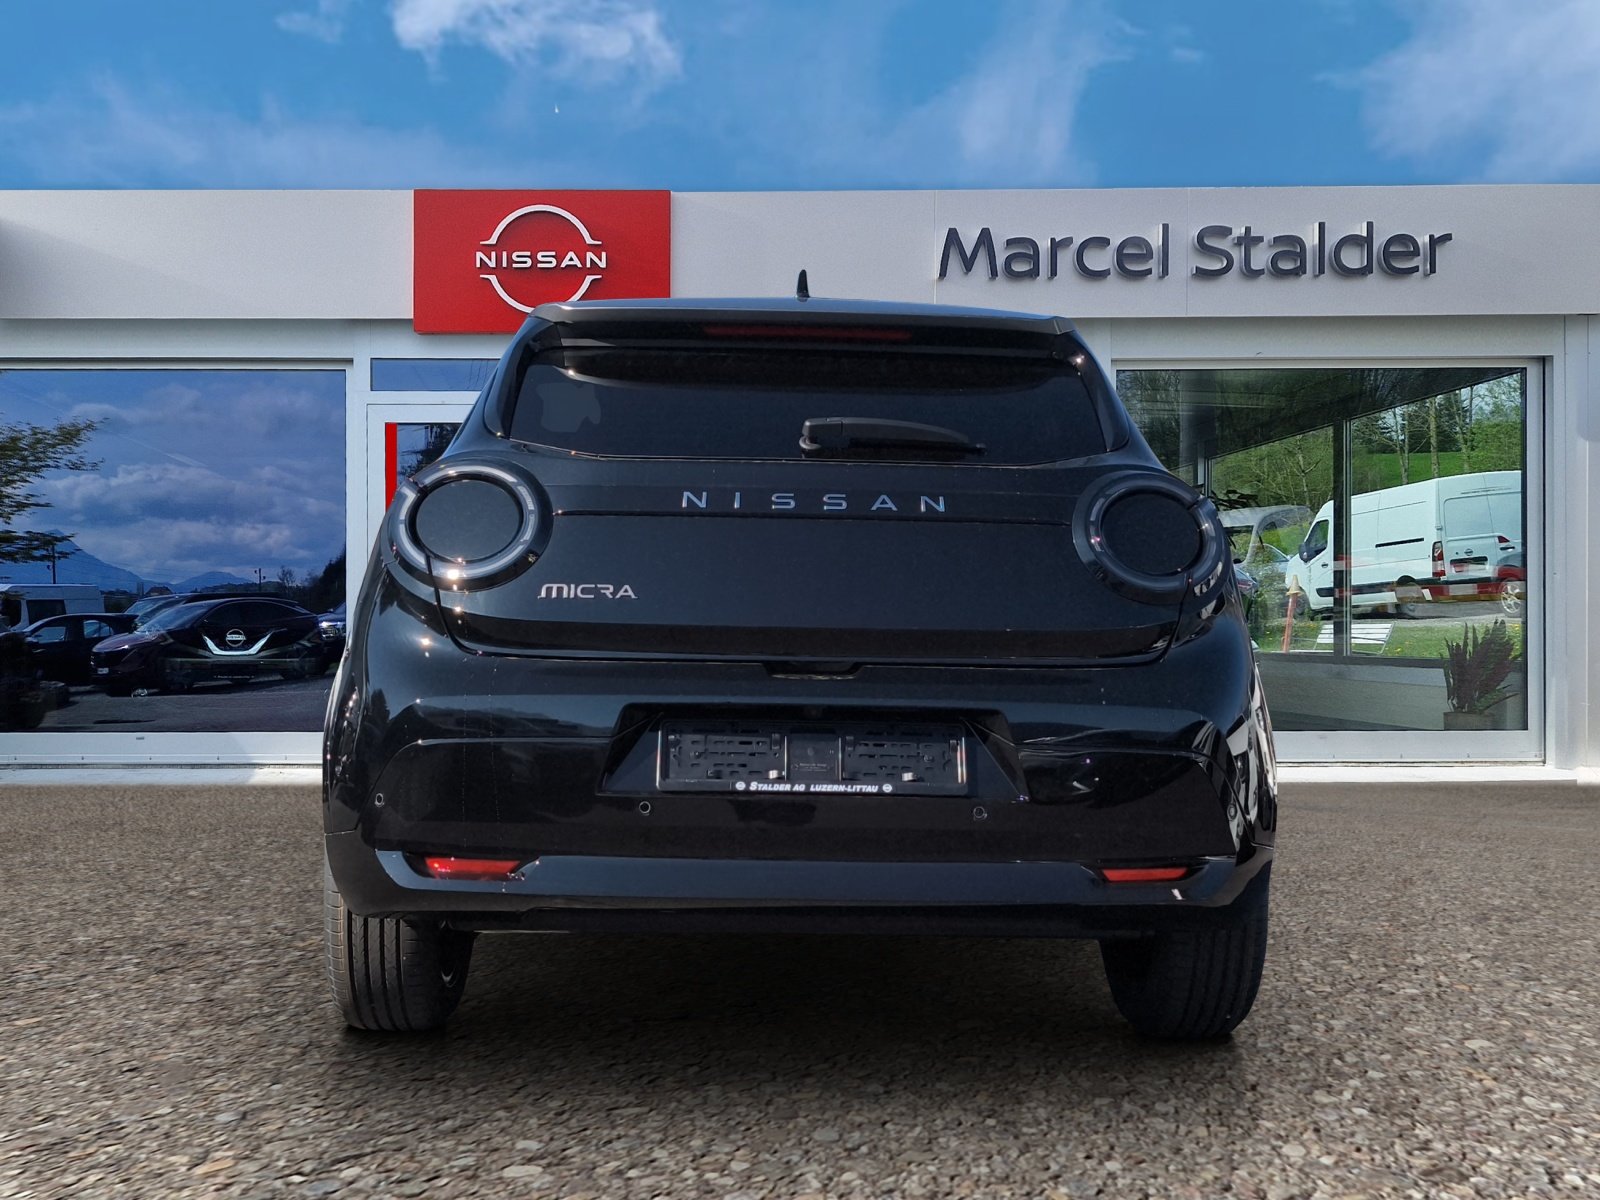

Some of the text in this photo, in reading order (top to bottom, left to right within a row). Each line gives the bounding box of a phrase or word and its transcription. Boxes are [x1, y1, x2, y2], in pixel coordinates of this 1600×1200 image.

[938, 221, 1453, 280] Marcel Stalder
[475, 251, 607, 268] NISSAN
[681, 491, 946, 513] NISSAN
[537, 583, 638, 599] MICRA
[749, 781, 879, 793] STALDER AG LUZERN-LITTAU
